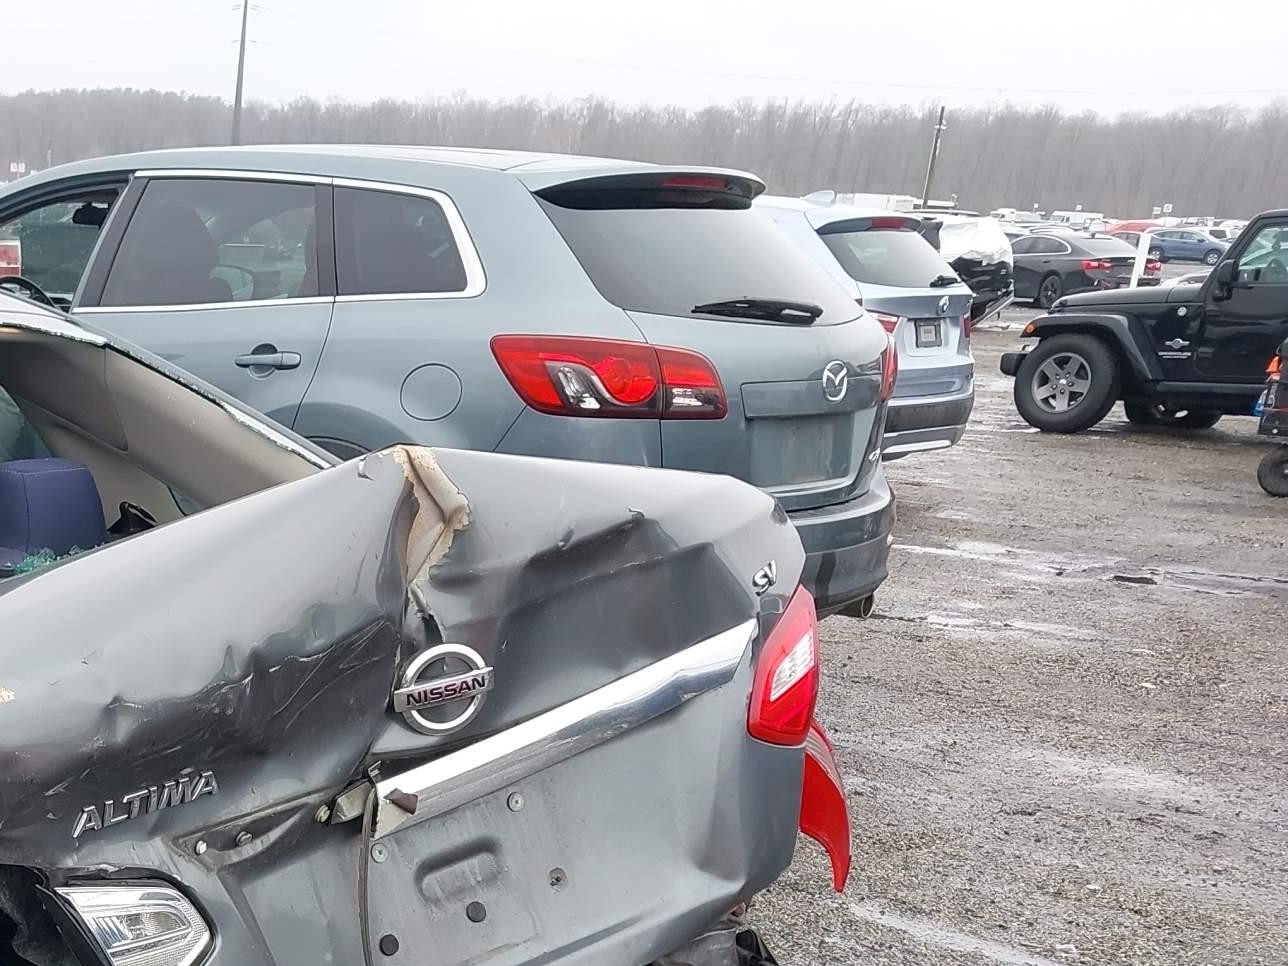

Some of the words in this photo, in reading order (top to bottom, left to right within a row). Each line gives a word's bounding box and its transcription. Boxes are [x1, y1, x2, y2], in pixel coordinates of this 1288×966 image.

[753, 559, 777, 593] SV
[405, 675, 487, 707] NISSAN
[71, 770, 220, 839] ALTIMA
